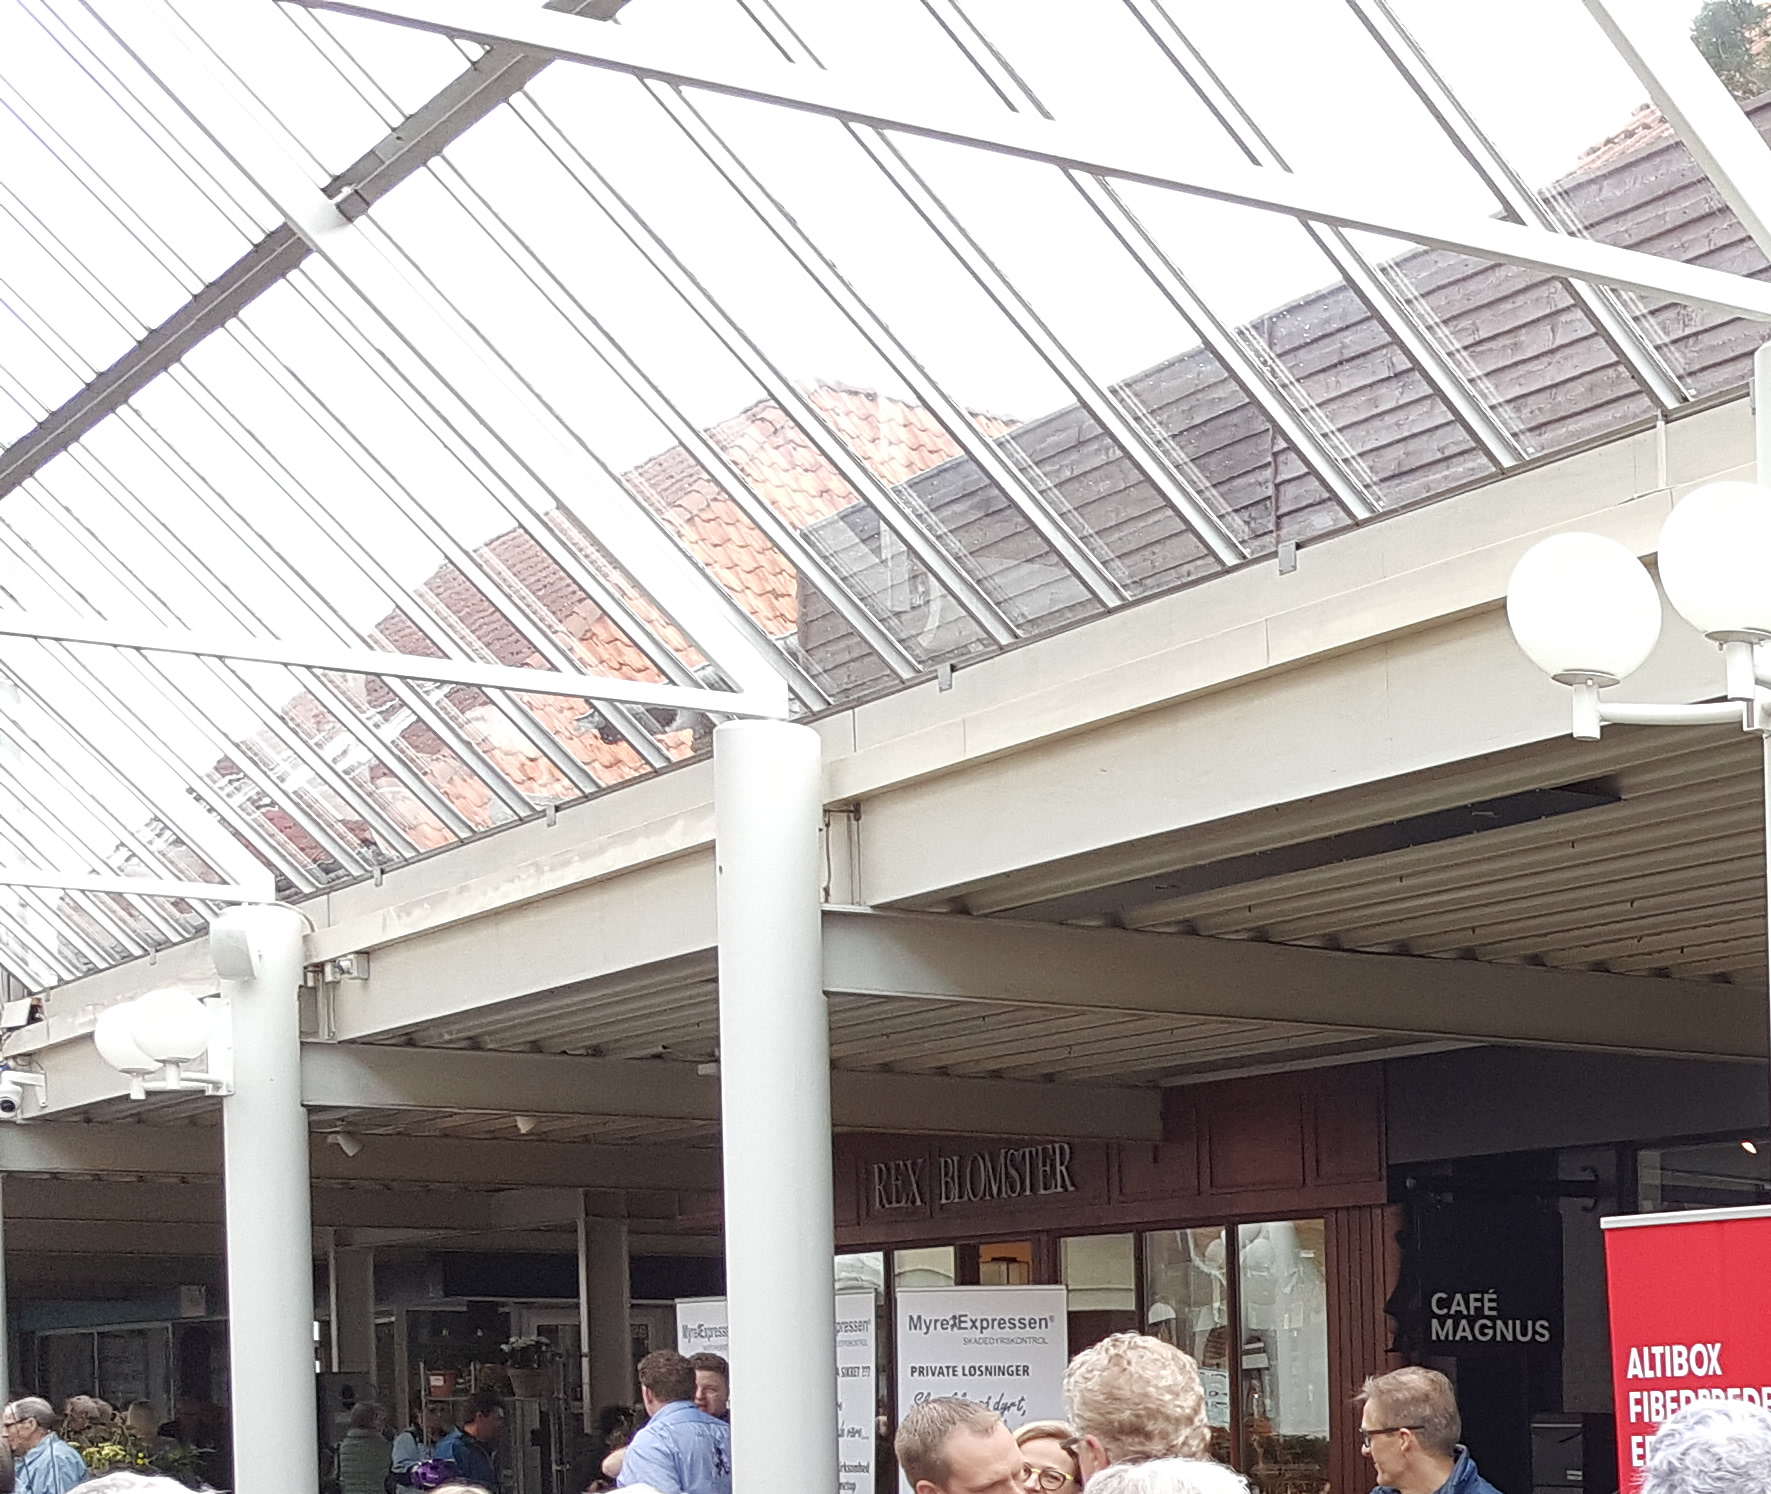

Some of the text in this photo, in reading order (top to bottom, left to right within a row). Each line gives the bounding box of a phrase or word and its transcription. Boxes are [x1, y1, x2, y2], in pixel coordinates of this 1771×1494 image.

[872, 1142, 1076, 1210] REX BLOMSTER
[1430, 1288, 1499, 1316] CAFÉ
[1430, 1318, 1551, 1343] MAGNUS
[910, 1364, 1030, 1378] PRIVATE LØSNINGER
[1626, 1342, 1724, 1380] ALTIBOX
